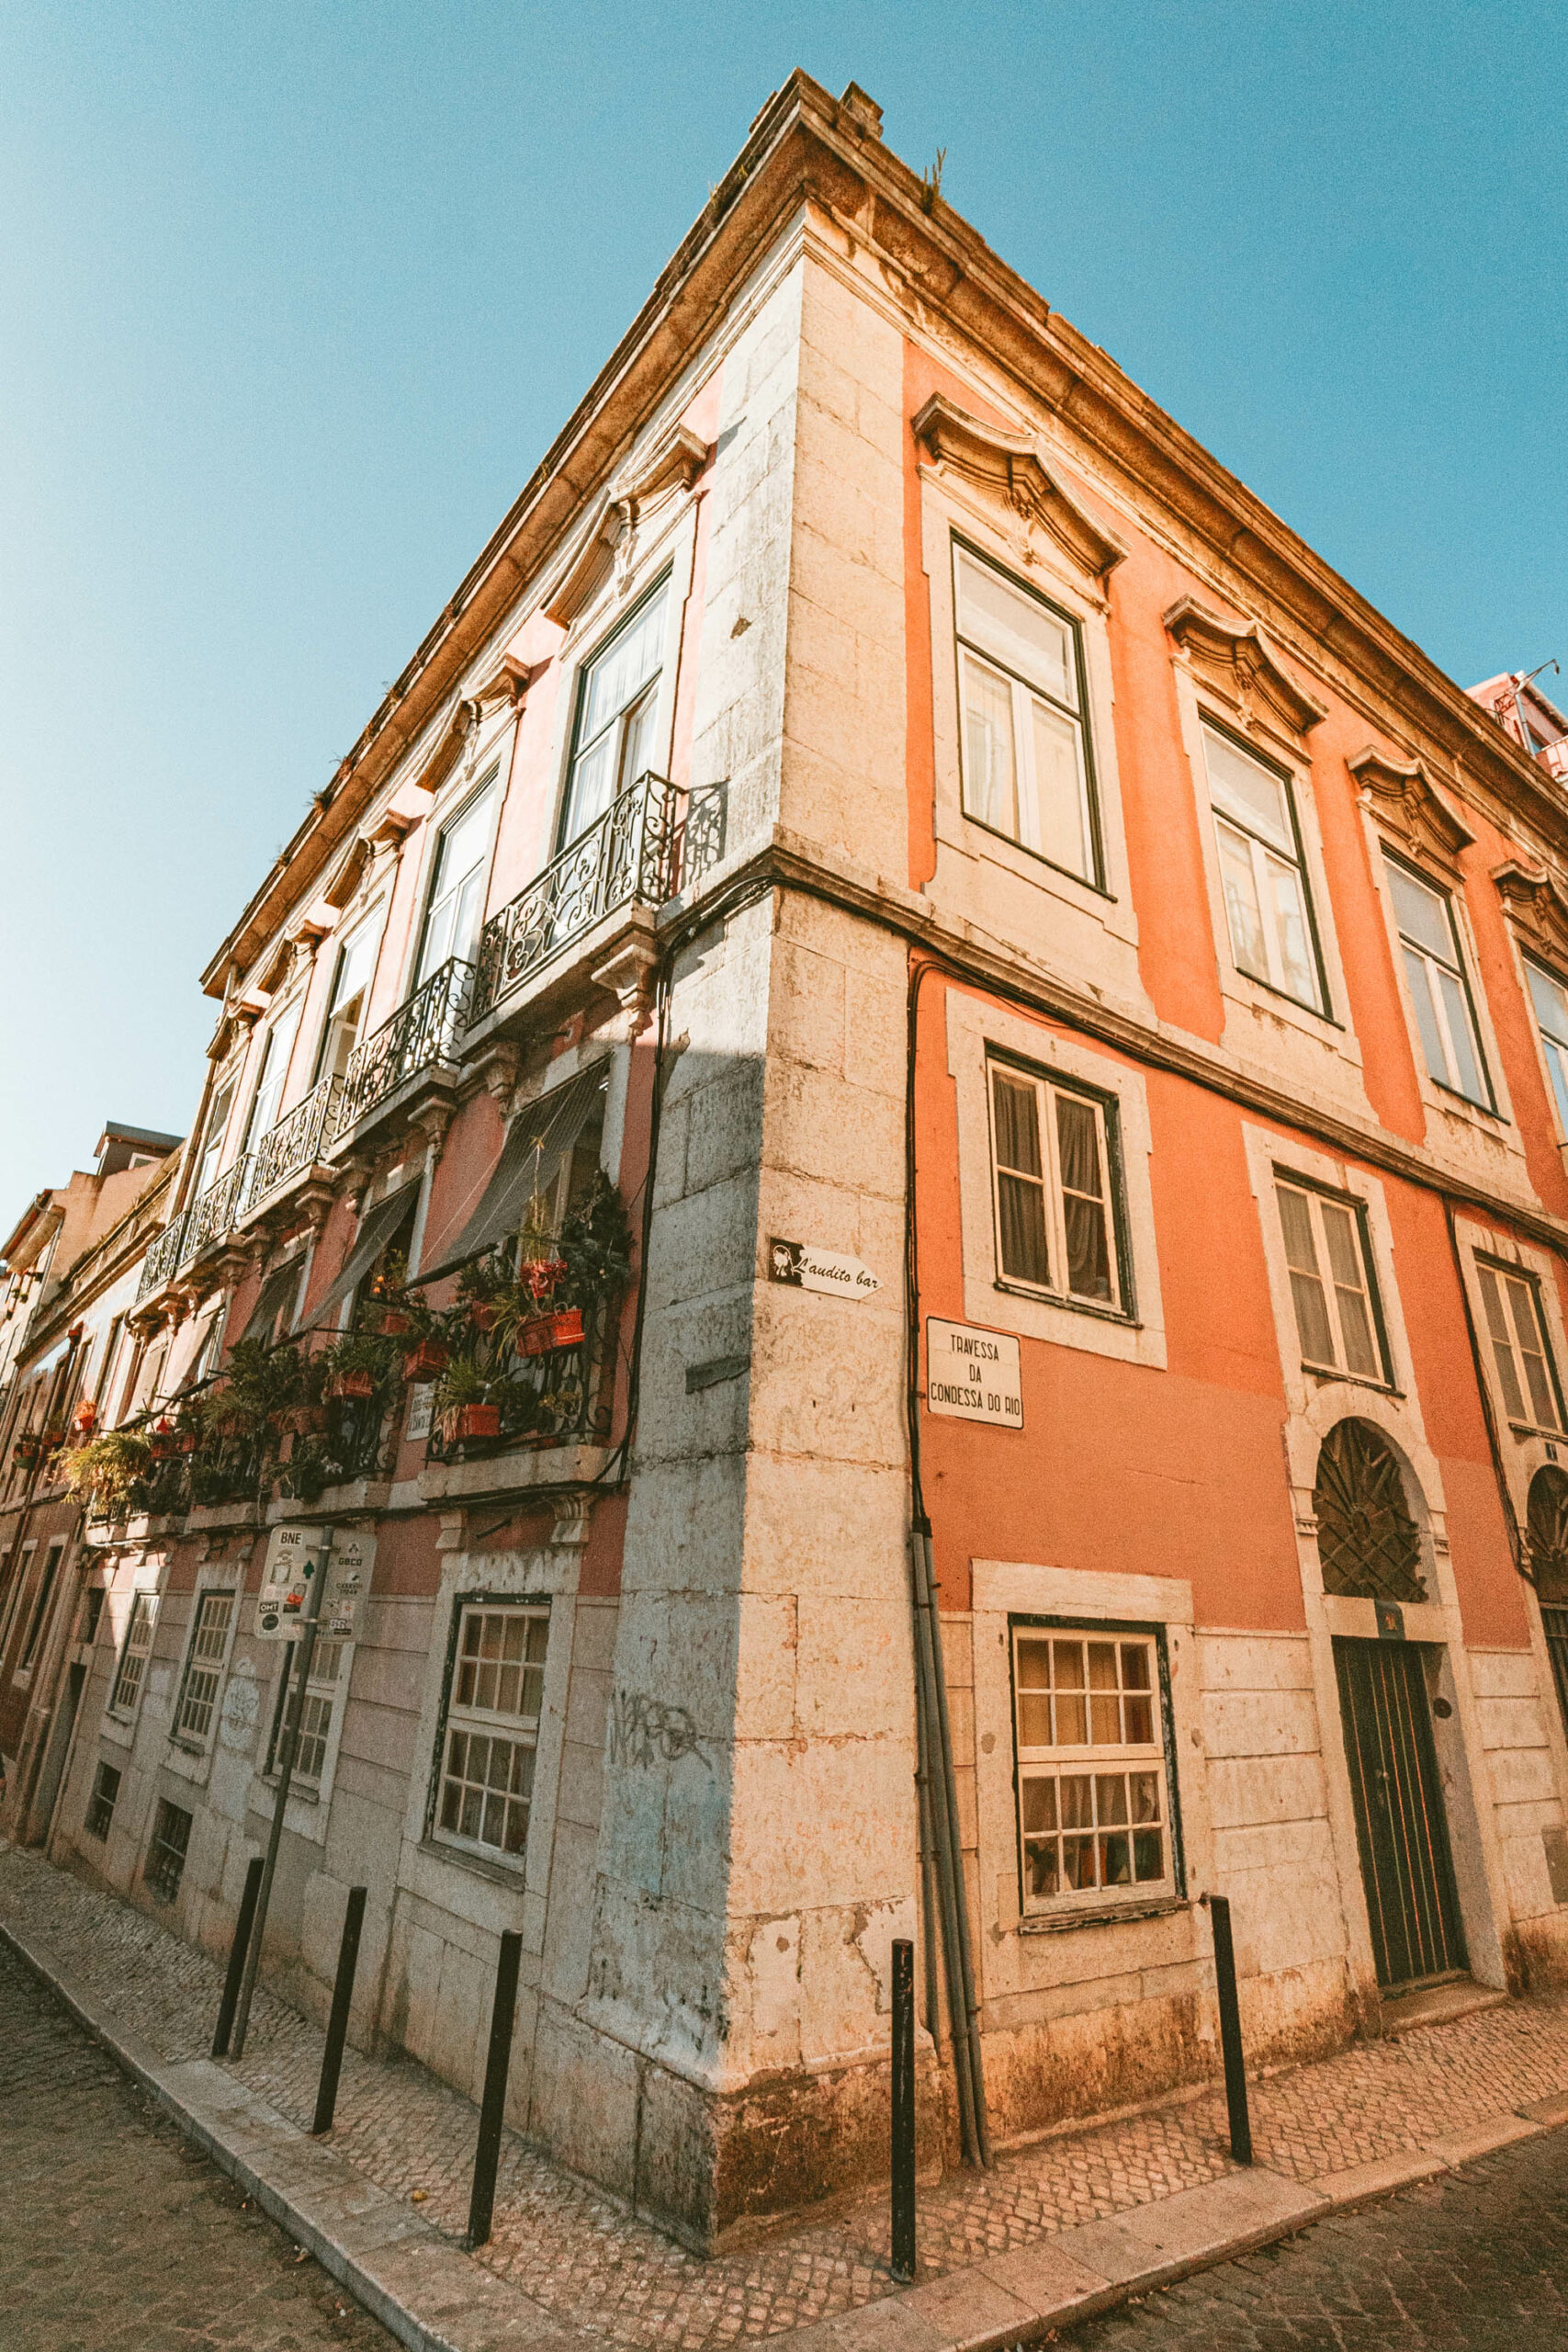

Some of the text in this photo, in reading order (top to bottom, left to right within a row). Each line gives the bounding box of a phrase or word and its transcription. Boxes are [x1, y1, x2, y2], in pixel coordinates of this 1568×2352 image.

[856, 1271, 878, 1288] bar
[951, 1334, 999, 1362] TRAVESSA
[969, 1364, 982, 1383] DA
[931, 1383, 1020, 1416] CONDESSA DO RIO
[280, 1532, 301, 1544] BNE
